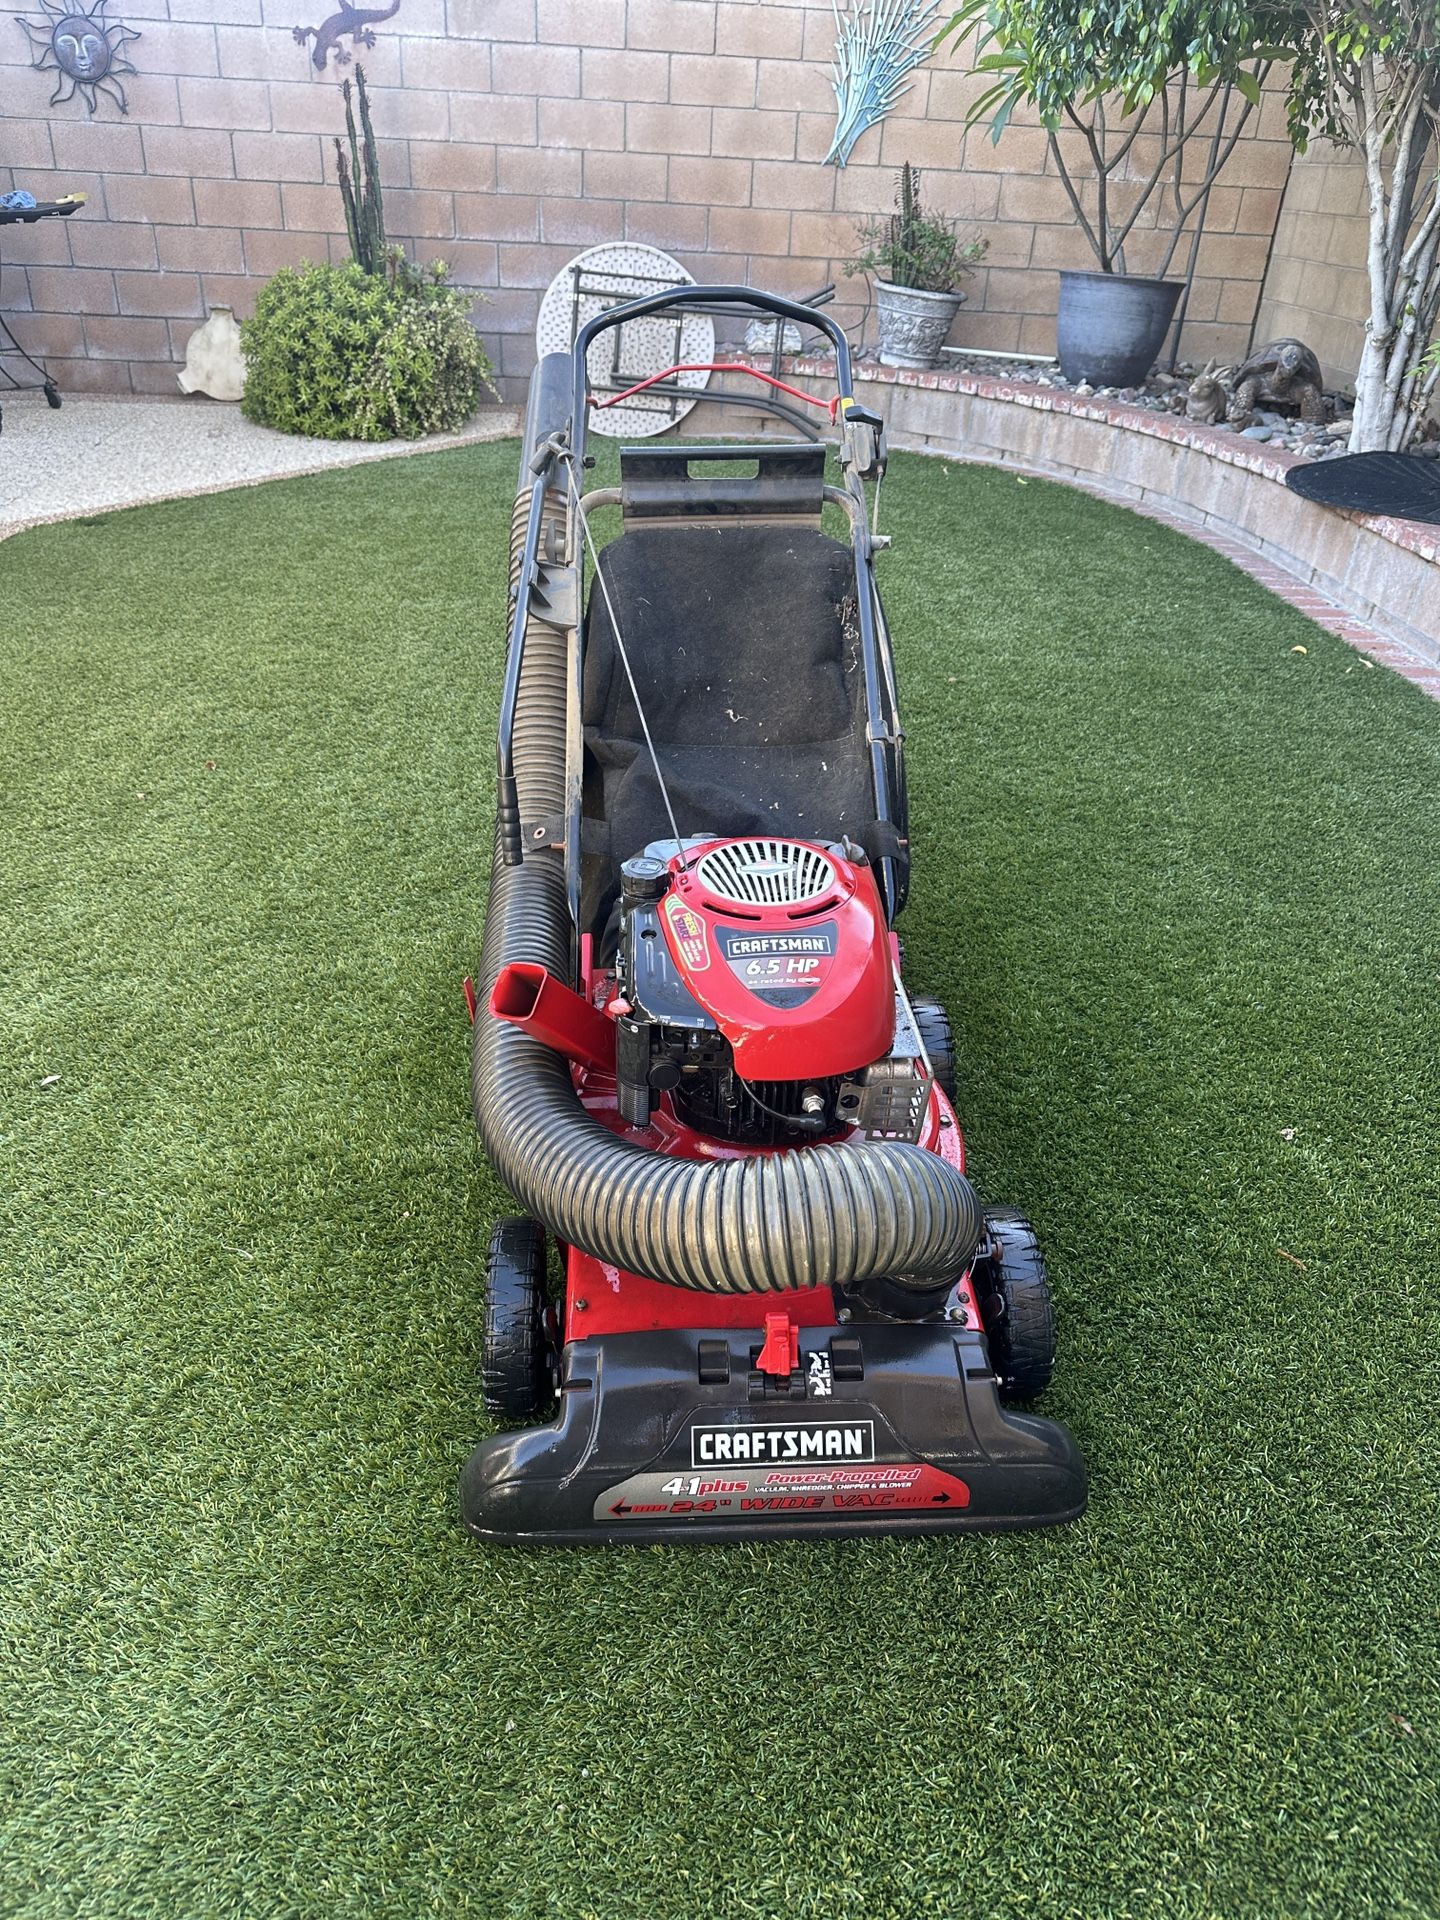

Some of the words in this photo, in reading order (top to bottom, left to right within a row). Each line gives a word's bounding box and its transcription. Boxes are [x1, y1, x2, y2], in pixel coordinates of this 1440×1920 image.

[732, 938, 824, 954] CRAFTSMAN
[746, 959, 780, 975] 6.5
[787, 959, 819, 973] HP
[700, 1430, 863, 1460] CRAFTSMAN
[765, 1468, 921, 1484] Power-Propelled
[836, 1482, 871, 1490] CHIPPER
[878, 1481, 913, 1489] BLOWER
[741, 1496, 825, 1510] WIDE
[833, 1494, 896, 1508] VAC
